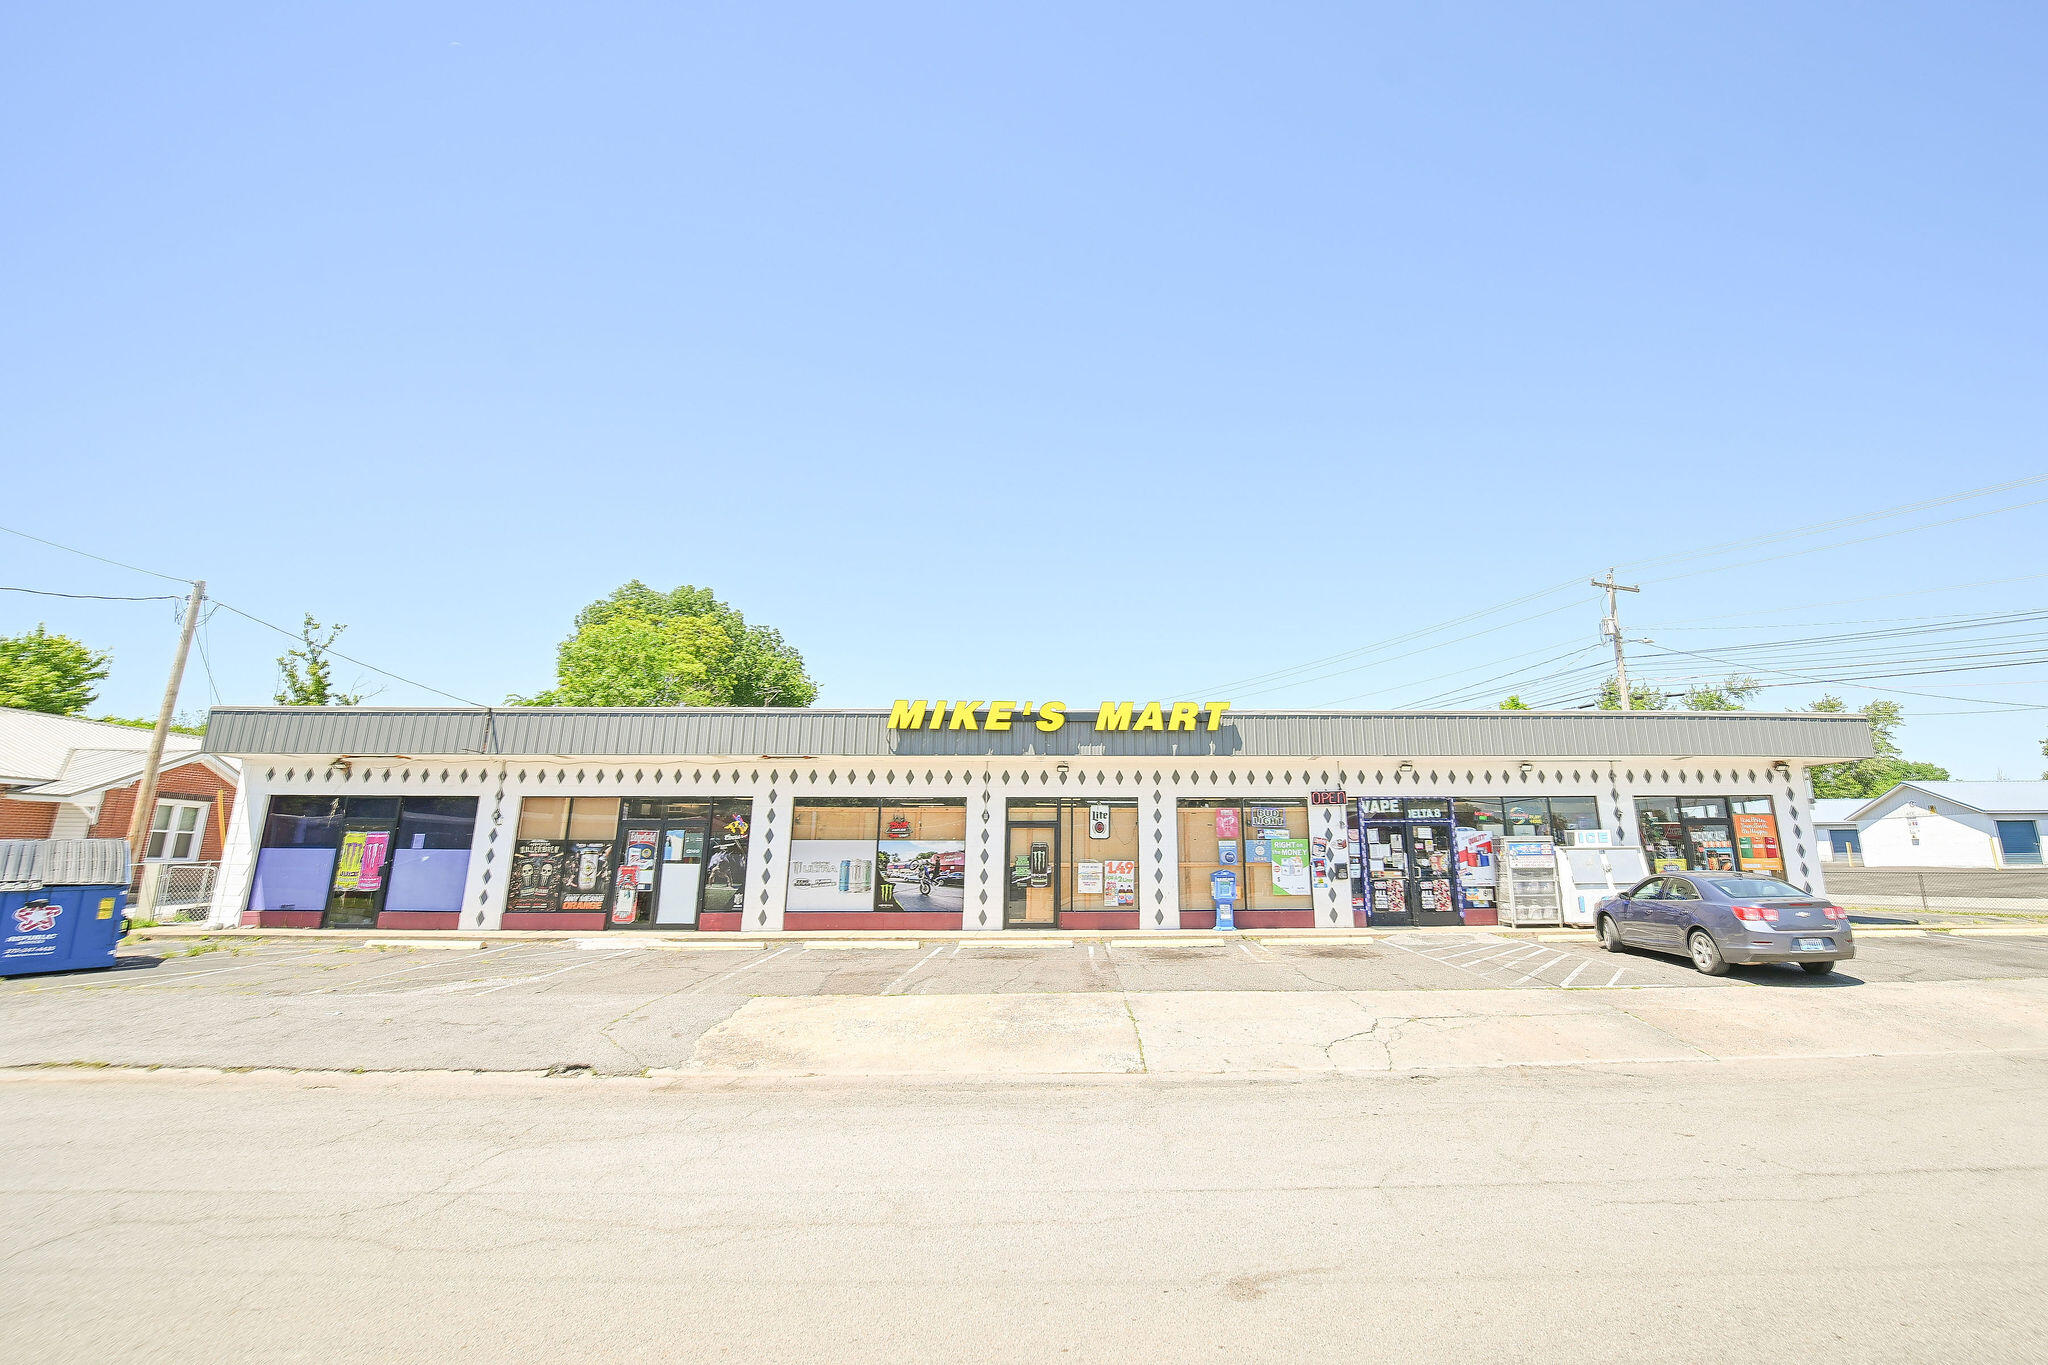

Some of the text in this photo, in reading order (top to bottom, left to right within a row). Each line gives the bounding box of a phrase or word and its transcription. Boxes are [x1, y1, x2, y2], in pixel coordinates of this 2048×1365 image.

[886, 699, 1231, 732] MIKE'S MART
[1312, 792, 1346, 804] OPEN
[1361, 800, 1399, 813] VAPE
[1092, 811, 1108, 821] Lite
[1256, 809, 1281, 818] BUD
[1253, 816, 1284, 826] LIGHT
[1578, 832, 1609, 843] ICE
